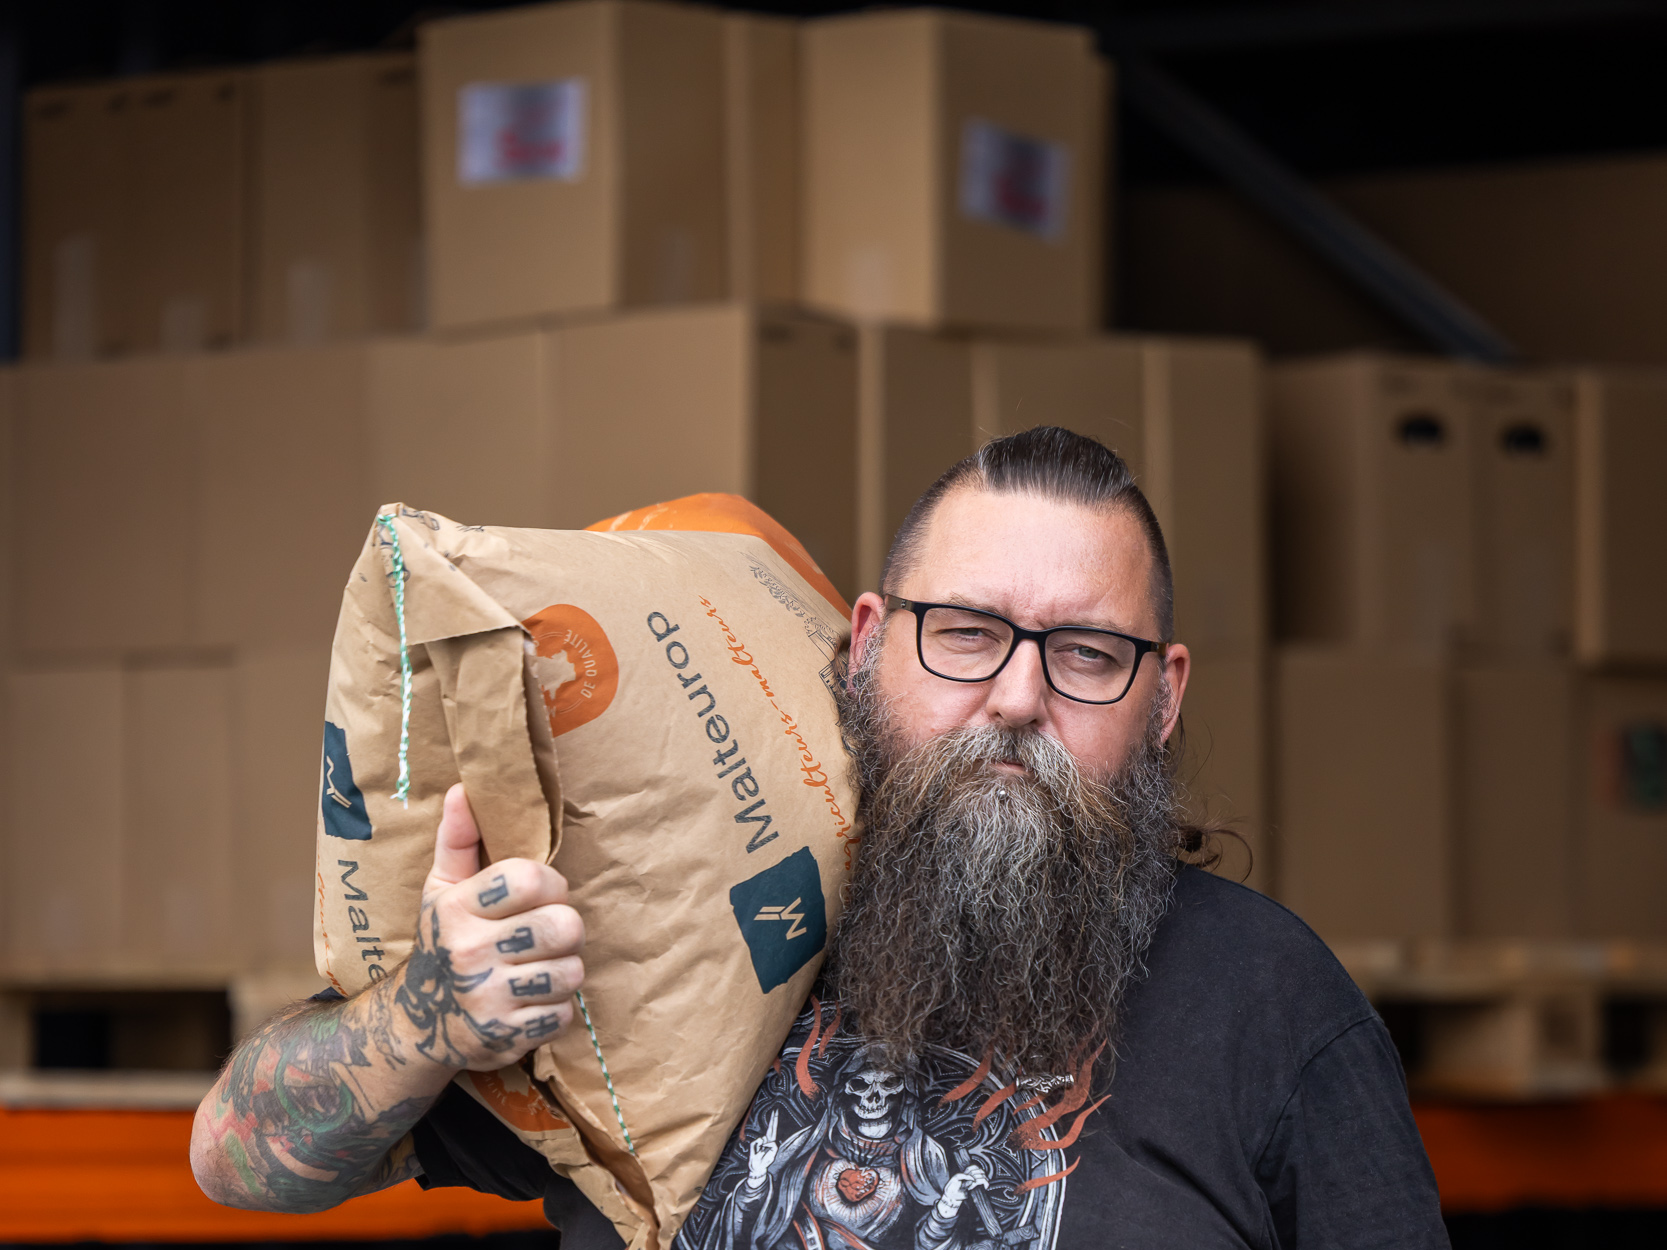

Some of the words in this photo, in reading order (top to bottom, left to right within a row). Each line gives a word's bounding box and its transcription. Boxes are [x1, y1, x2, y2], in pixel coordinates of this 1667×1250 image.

[562, 629, 598, 677] QUALITÉ
[580, 681, 597, 699] DE
[646, 610, 780, 854] Malteurop
[337, 859, 388, 985] Malte
